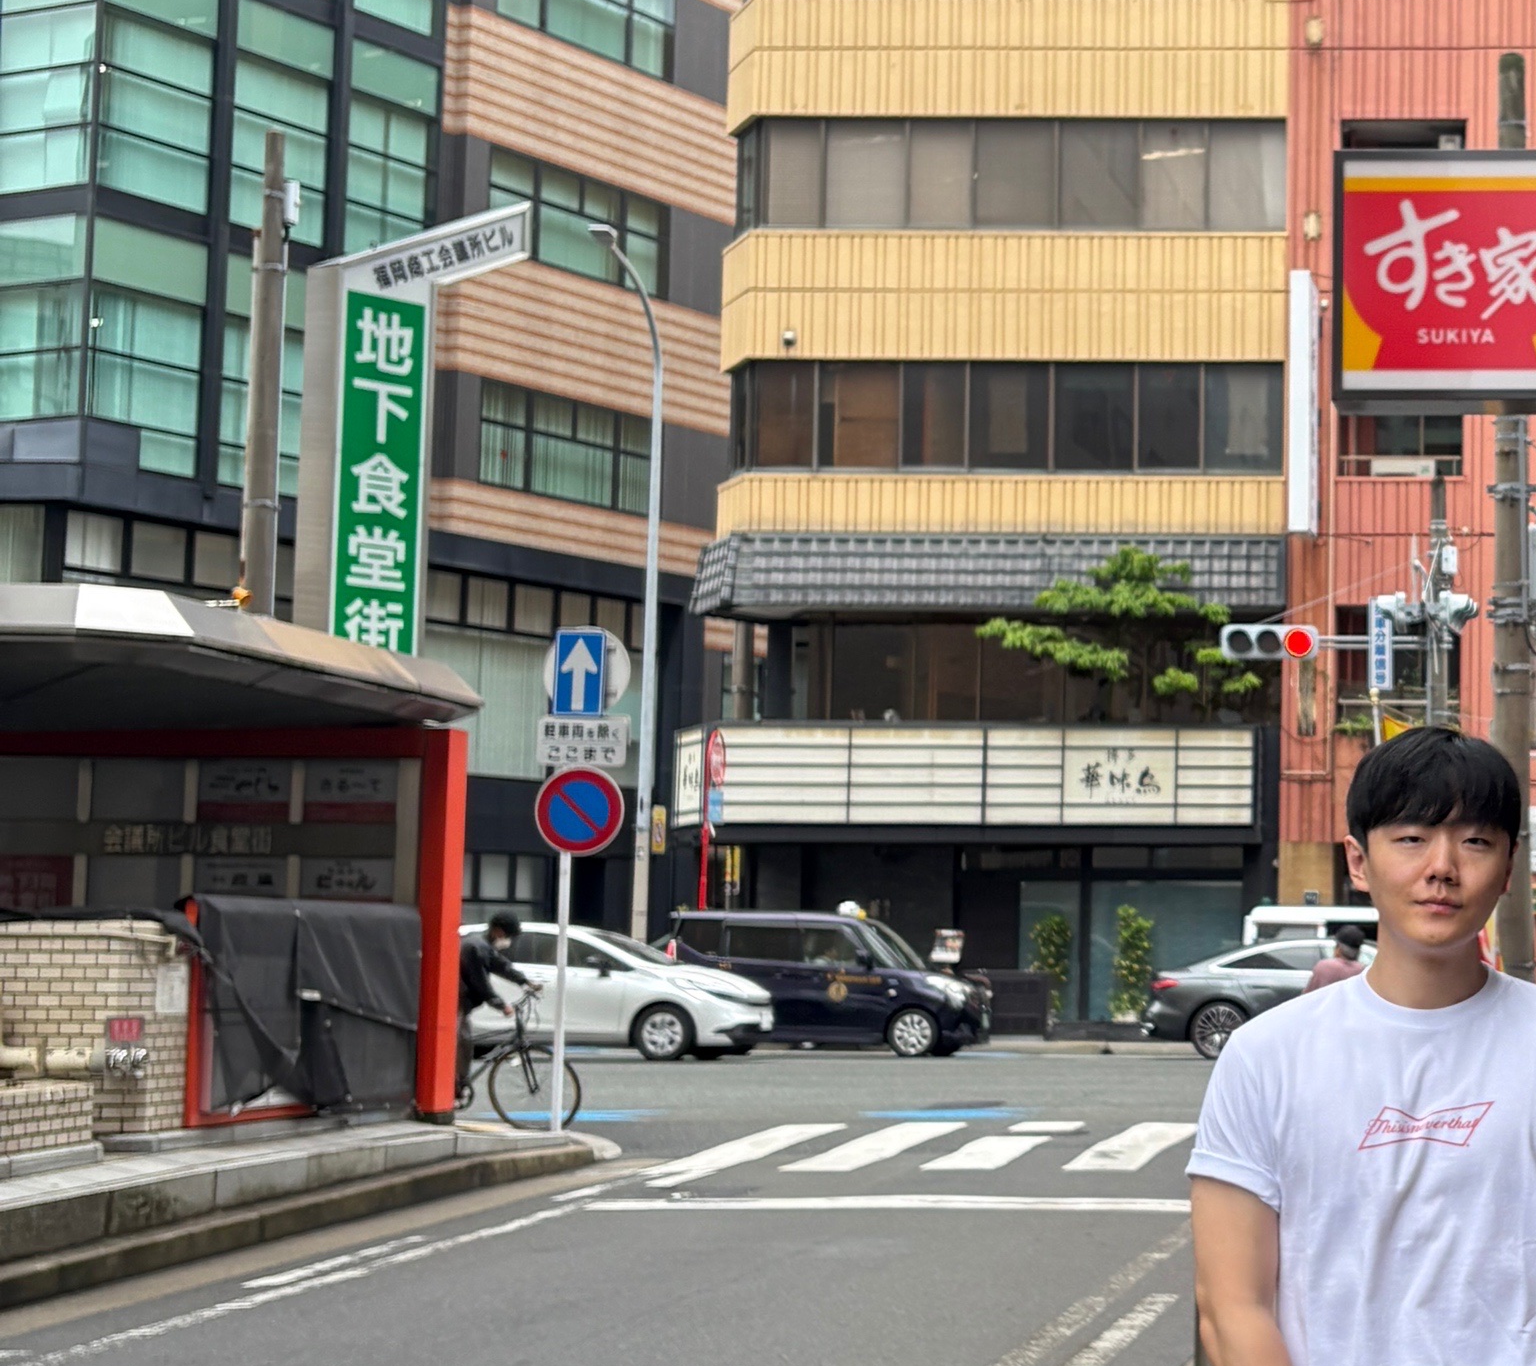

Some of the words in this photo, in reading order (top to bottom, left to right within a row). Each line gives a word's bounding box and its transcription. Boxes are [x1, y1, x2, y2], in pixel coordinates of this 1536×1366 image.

[1417, 327, 1496, 345] SUKIYA
[343, 306, 415, 654] 地下食堂街
[547, 745, 617, 763] ここまで
